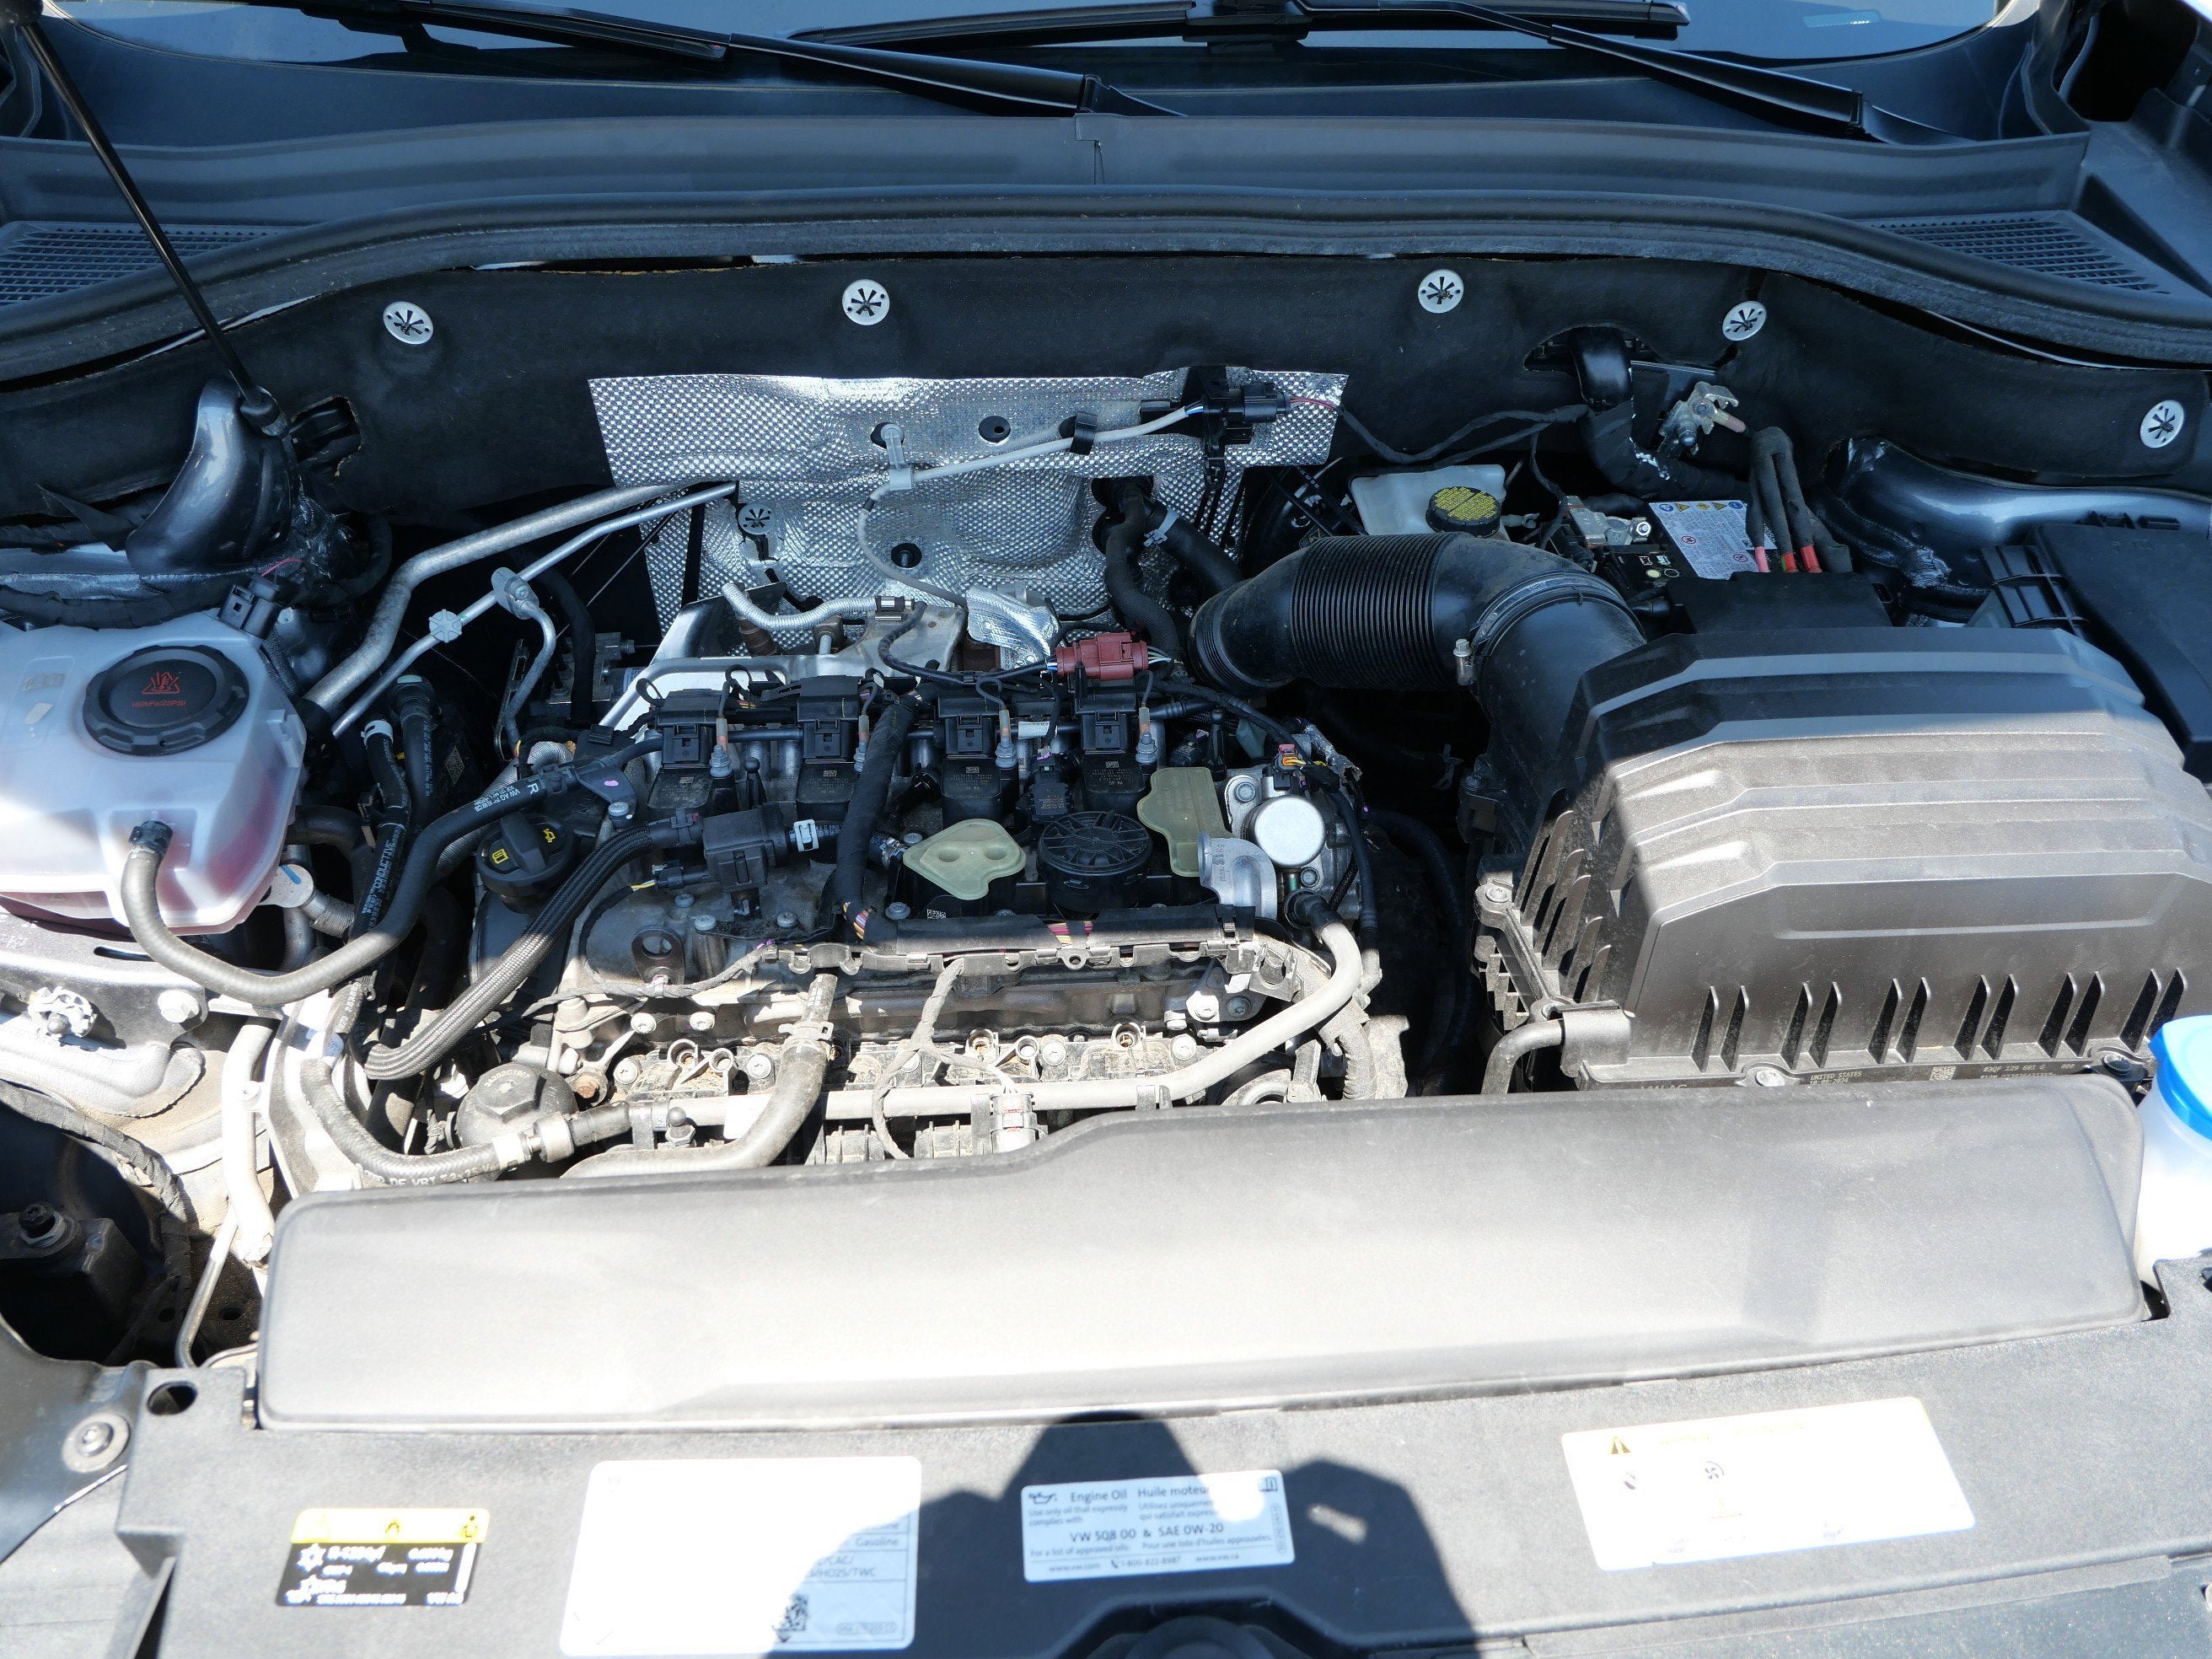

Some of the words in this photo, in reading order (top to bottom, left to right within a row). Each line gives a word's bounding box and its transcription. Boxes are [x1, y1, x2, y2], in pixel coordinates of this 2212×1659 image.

[1071, 1491, 1109, 1504] Engine
[1111, 1489, 1128, 1501] Oil
[1137, 1487, 1168, 1498] Huile
[1044, 1507, 1061, 1517] only
[1074, 1505, 1090, 1513] that
[1092, 1504, 1128, 1514] expressly
[1069, 1531, 1092, 1543] VW
[1094, 1529, 1117, 1542] 508
[1119, 1528, 1136, 1539] 00
[1142, 1529, 1152, 1538] &
[1157, 1524, 1180, 1537] SAE
[1183, 1522, 1224, 1534] 0W-20
[1076, 1544, 1114, 1554] approved
